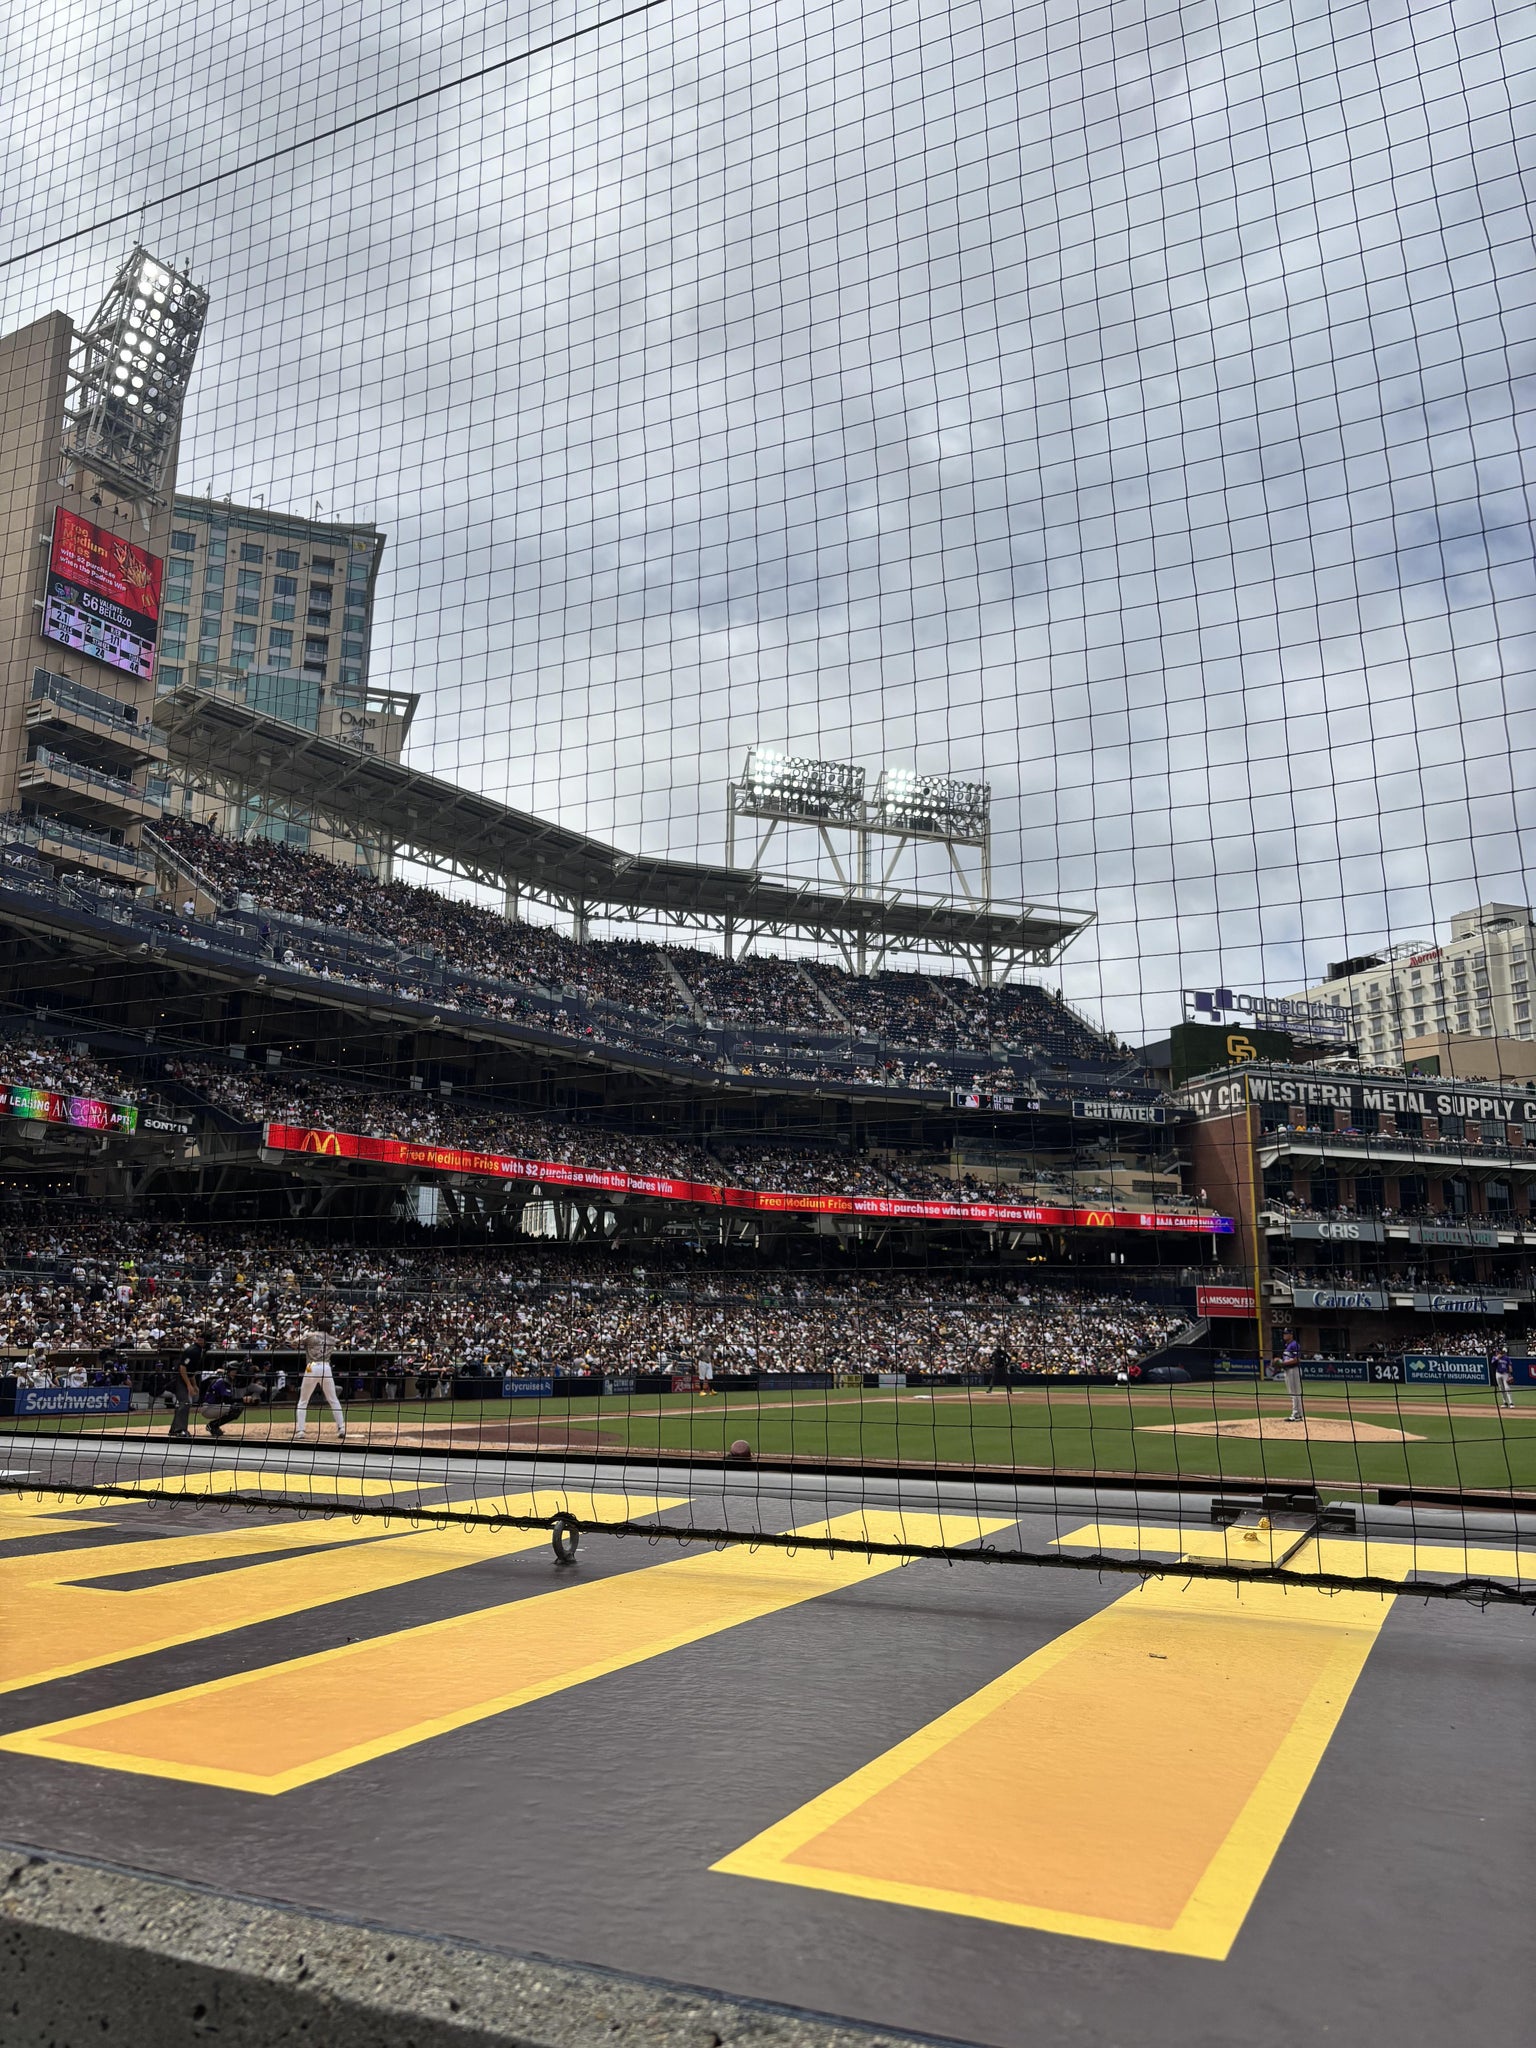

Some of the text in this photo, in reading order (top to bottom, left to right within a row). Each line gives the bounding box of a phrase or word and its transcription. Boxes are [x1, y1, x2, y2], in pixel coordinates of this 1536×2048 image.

[82, 592, 98, 611] 56
[99, 598, 123, 615] VALENTE
[99, 605, 132, 628] BELLOZO
[86, 624, 92, 634] 2
[59, 631, 139, 673] 20 24 44
[340, 711, 376, 728] OMNI
[1238, 994, 1346, 1021] QuidelOrtho
[10, 1096, 50, 1112] LEASING
[1248, 1077, 1352, 1108] WESTERN
[1363, 1089, 1431, 1116] METAL
[1437, 1094, 1514, 1121] SUPPLY
[1084, 1101, 1155, 1122] CUTWATER
[144, 1118, 176, 1132] SONY
[400, 1146, 673, 1194] Free Medium Fries with $2 purchase when the Padres Win
[759, 1195, 1042, 1220] Free Medium Fries with $2 purchase when the Padres Win
[1209, 1296, 1255, 1305] MISSION FED
[1271, 1309, 1292, 1324] 336
[1375, 1365, 1399, 1380] 342
[1428, 1360, 1484, 1373] Palomar
[25, 1391, 110, 1411] Southwest
